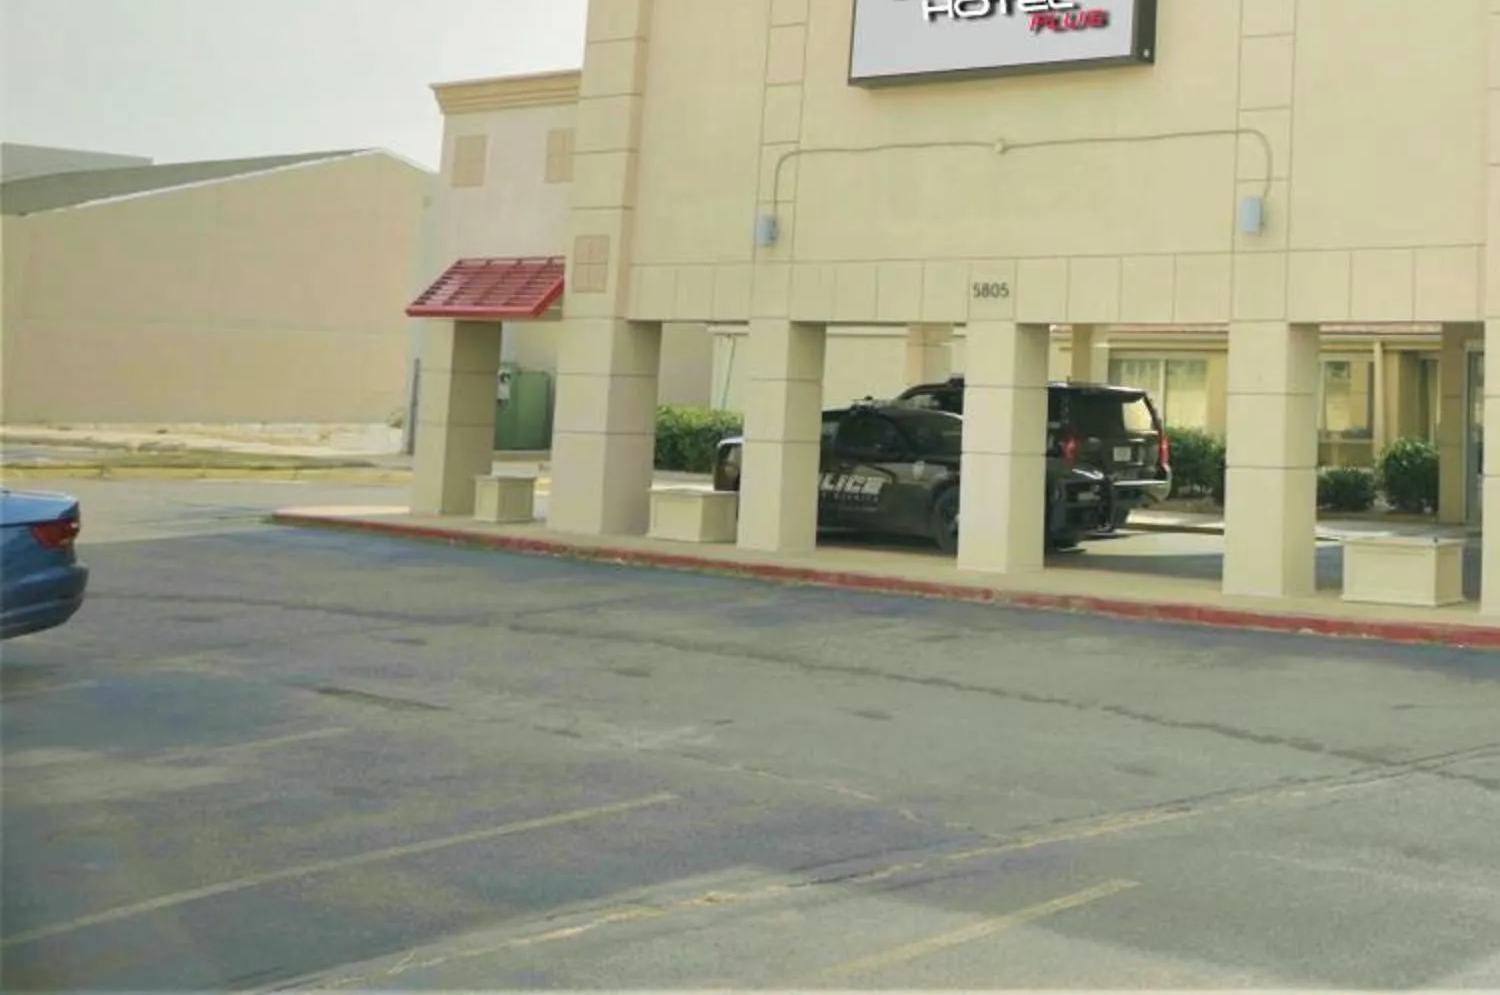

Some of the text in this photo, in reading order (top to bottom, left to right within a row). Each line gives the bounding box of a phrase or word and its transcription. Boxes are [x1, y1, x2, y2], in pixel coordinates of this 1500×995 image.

[1028, 8, 1109, 32] PLUS
[972, 282, 1010, 299] 5805
[819, 472, 885, 494] LICE
